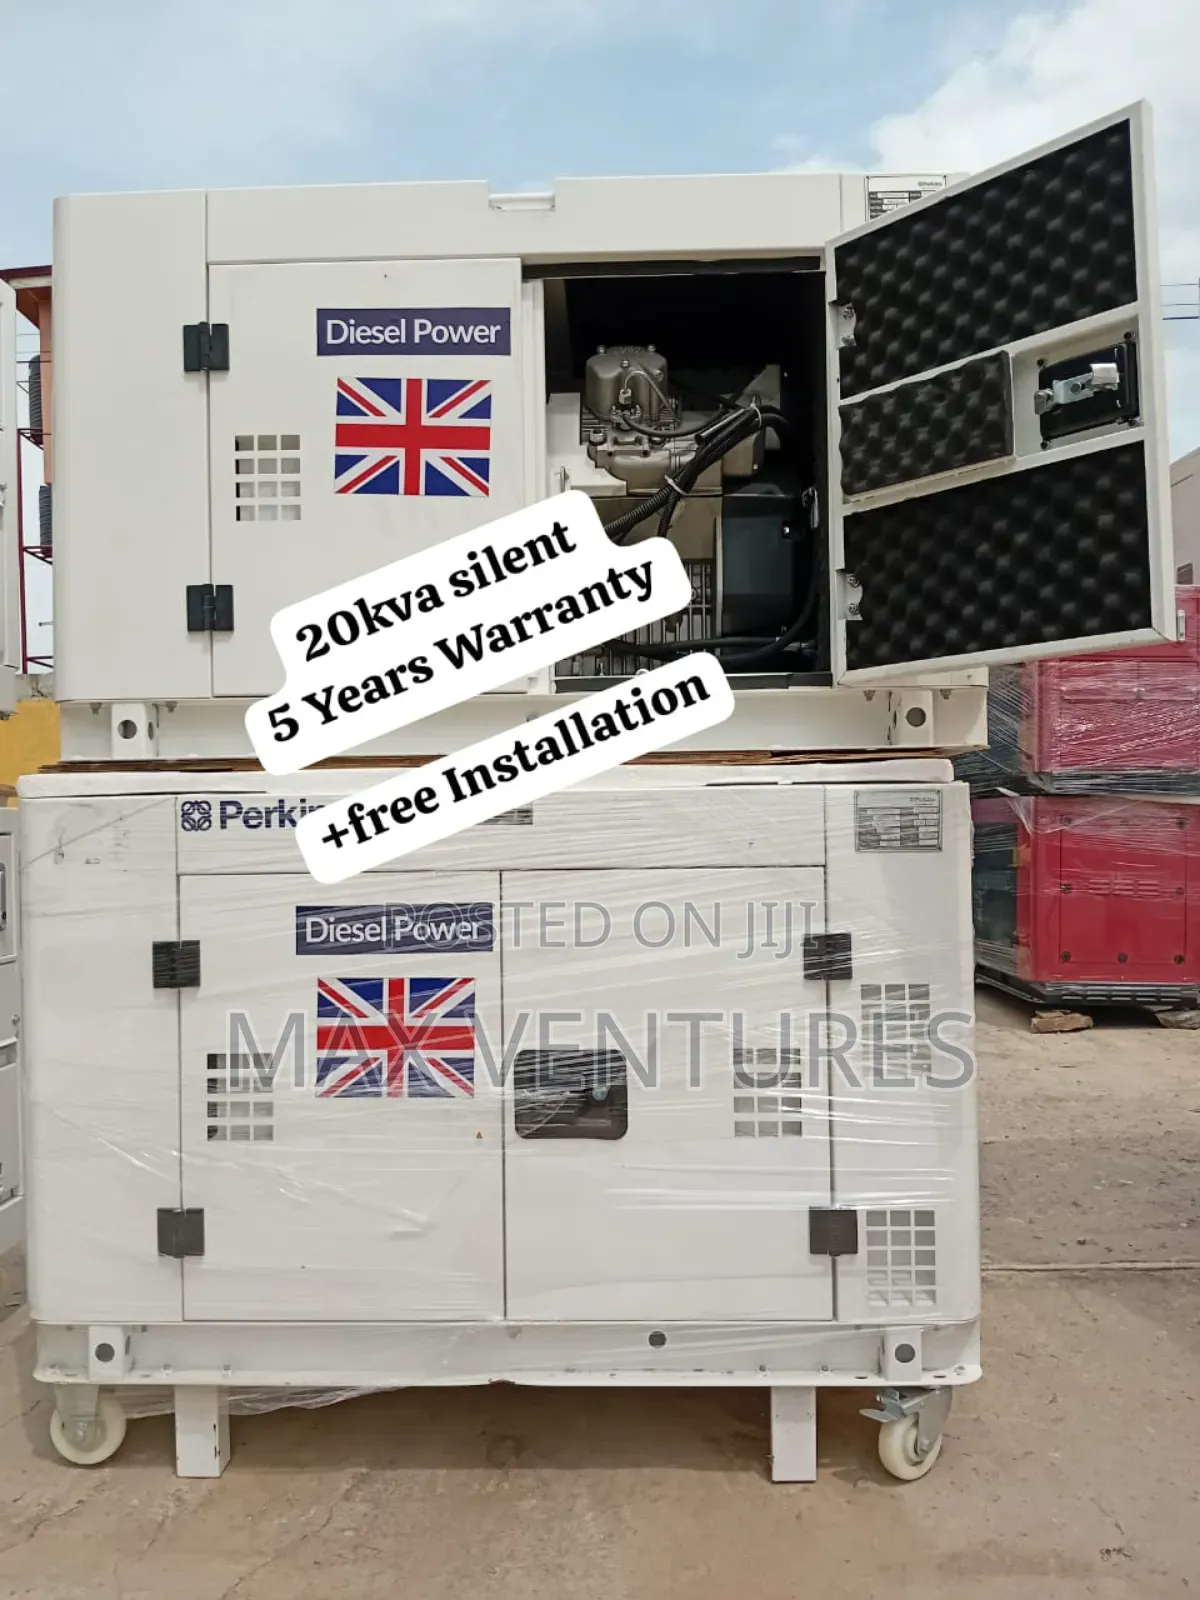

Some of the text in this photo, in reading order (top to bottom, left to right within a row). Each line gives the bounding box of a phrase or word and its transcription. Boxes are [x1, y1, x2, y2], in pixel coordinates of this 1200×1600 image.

[326, 319, 501, 345] Diesel Power
[305, 915, 482, 943] Diesel Power
